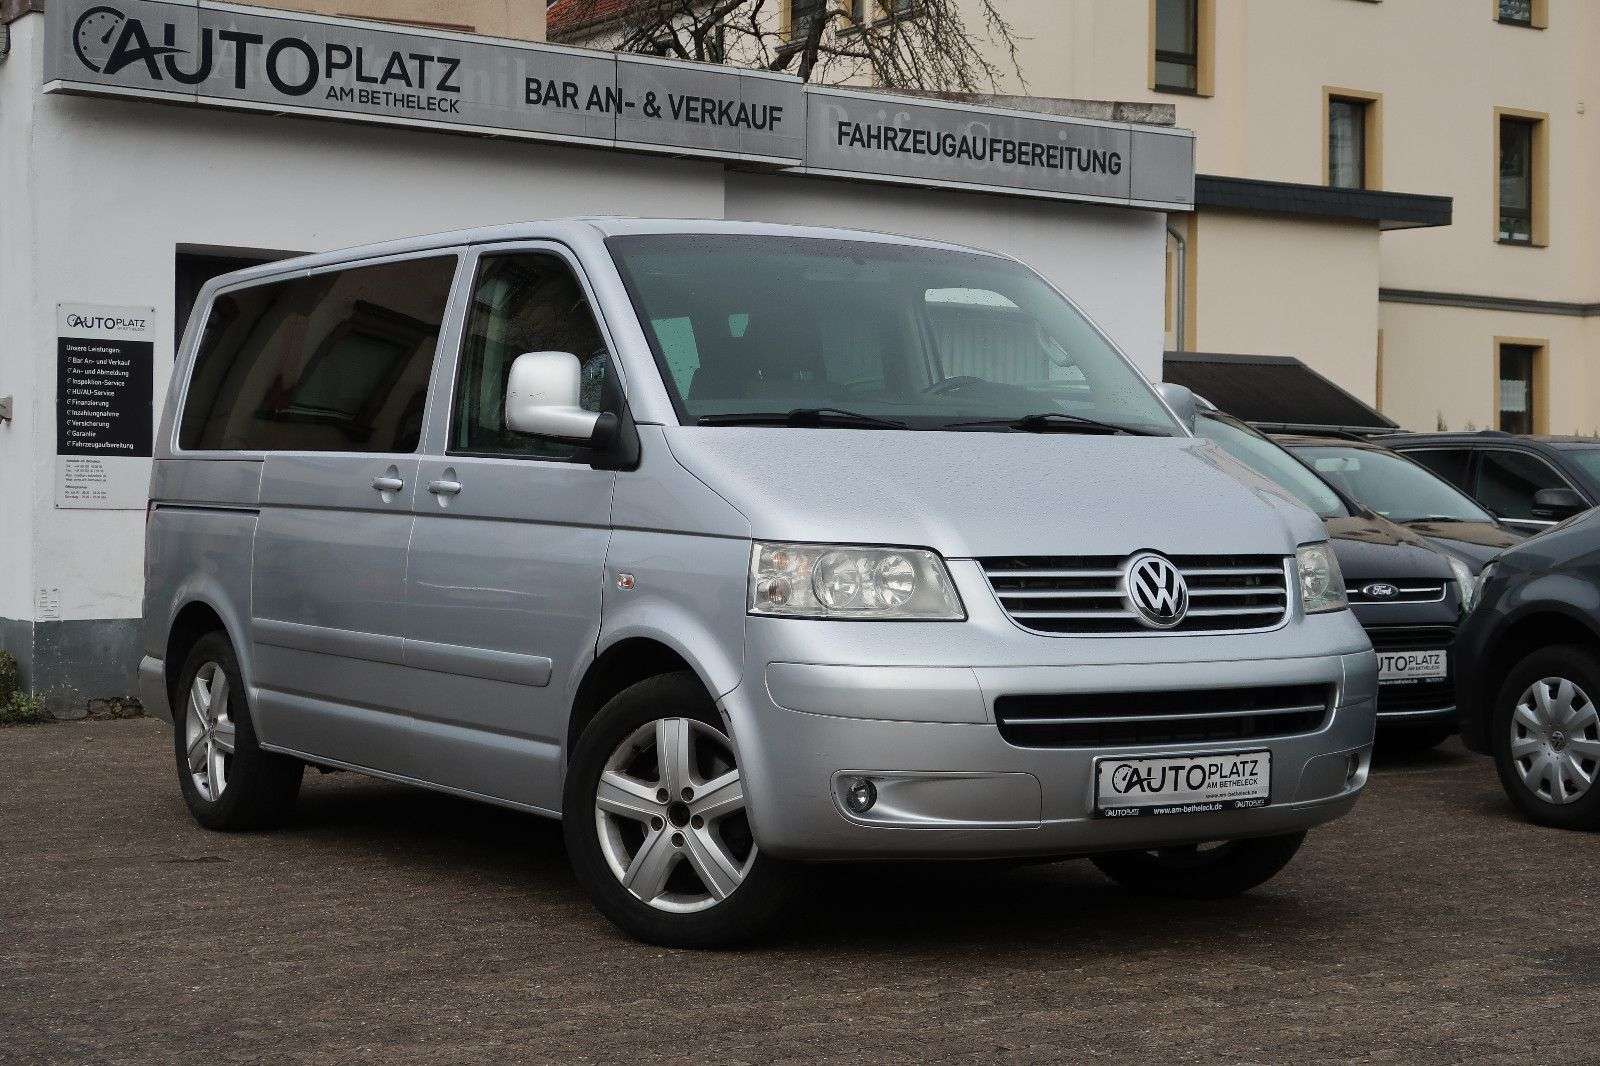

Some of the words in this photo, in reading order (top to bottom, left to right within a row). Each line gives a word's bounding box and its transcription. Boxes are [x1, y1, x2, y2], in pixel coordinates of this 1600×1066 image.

[325, 85, 354, 103] AM
[357, 88, 460, 114] BETHELECK
[525, 77, 579, 110] BAR
[585, 84, 636, 115] AN-
[642, 91, 663, 119] &
[668, 93, 783, 131] VERKAUF
[837, 121, 1122, 176] FAHRZEUGAUFBEREITUNG
[66, 344, 87, 352] Unsere
[96, 369, 129, 378] Abmeldung
[71, 398, 110, 408] Finanzierung
[71, 419, 110, 429] Versicherung
[71, 430, 97, 438] Garantie
[1206, 781, 1219, 789] AM
[1219, 777, 1259, 789] BETHELECK
[1153, 803, 1223, 815] www.am-betheleck.de
